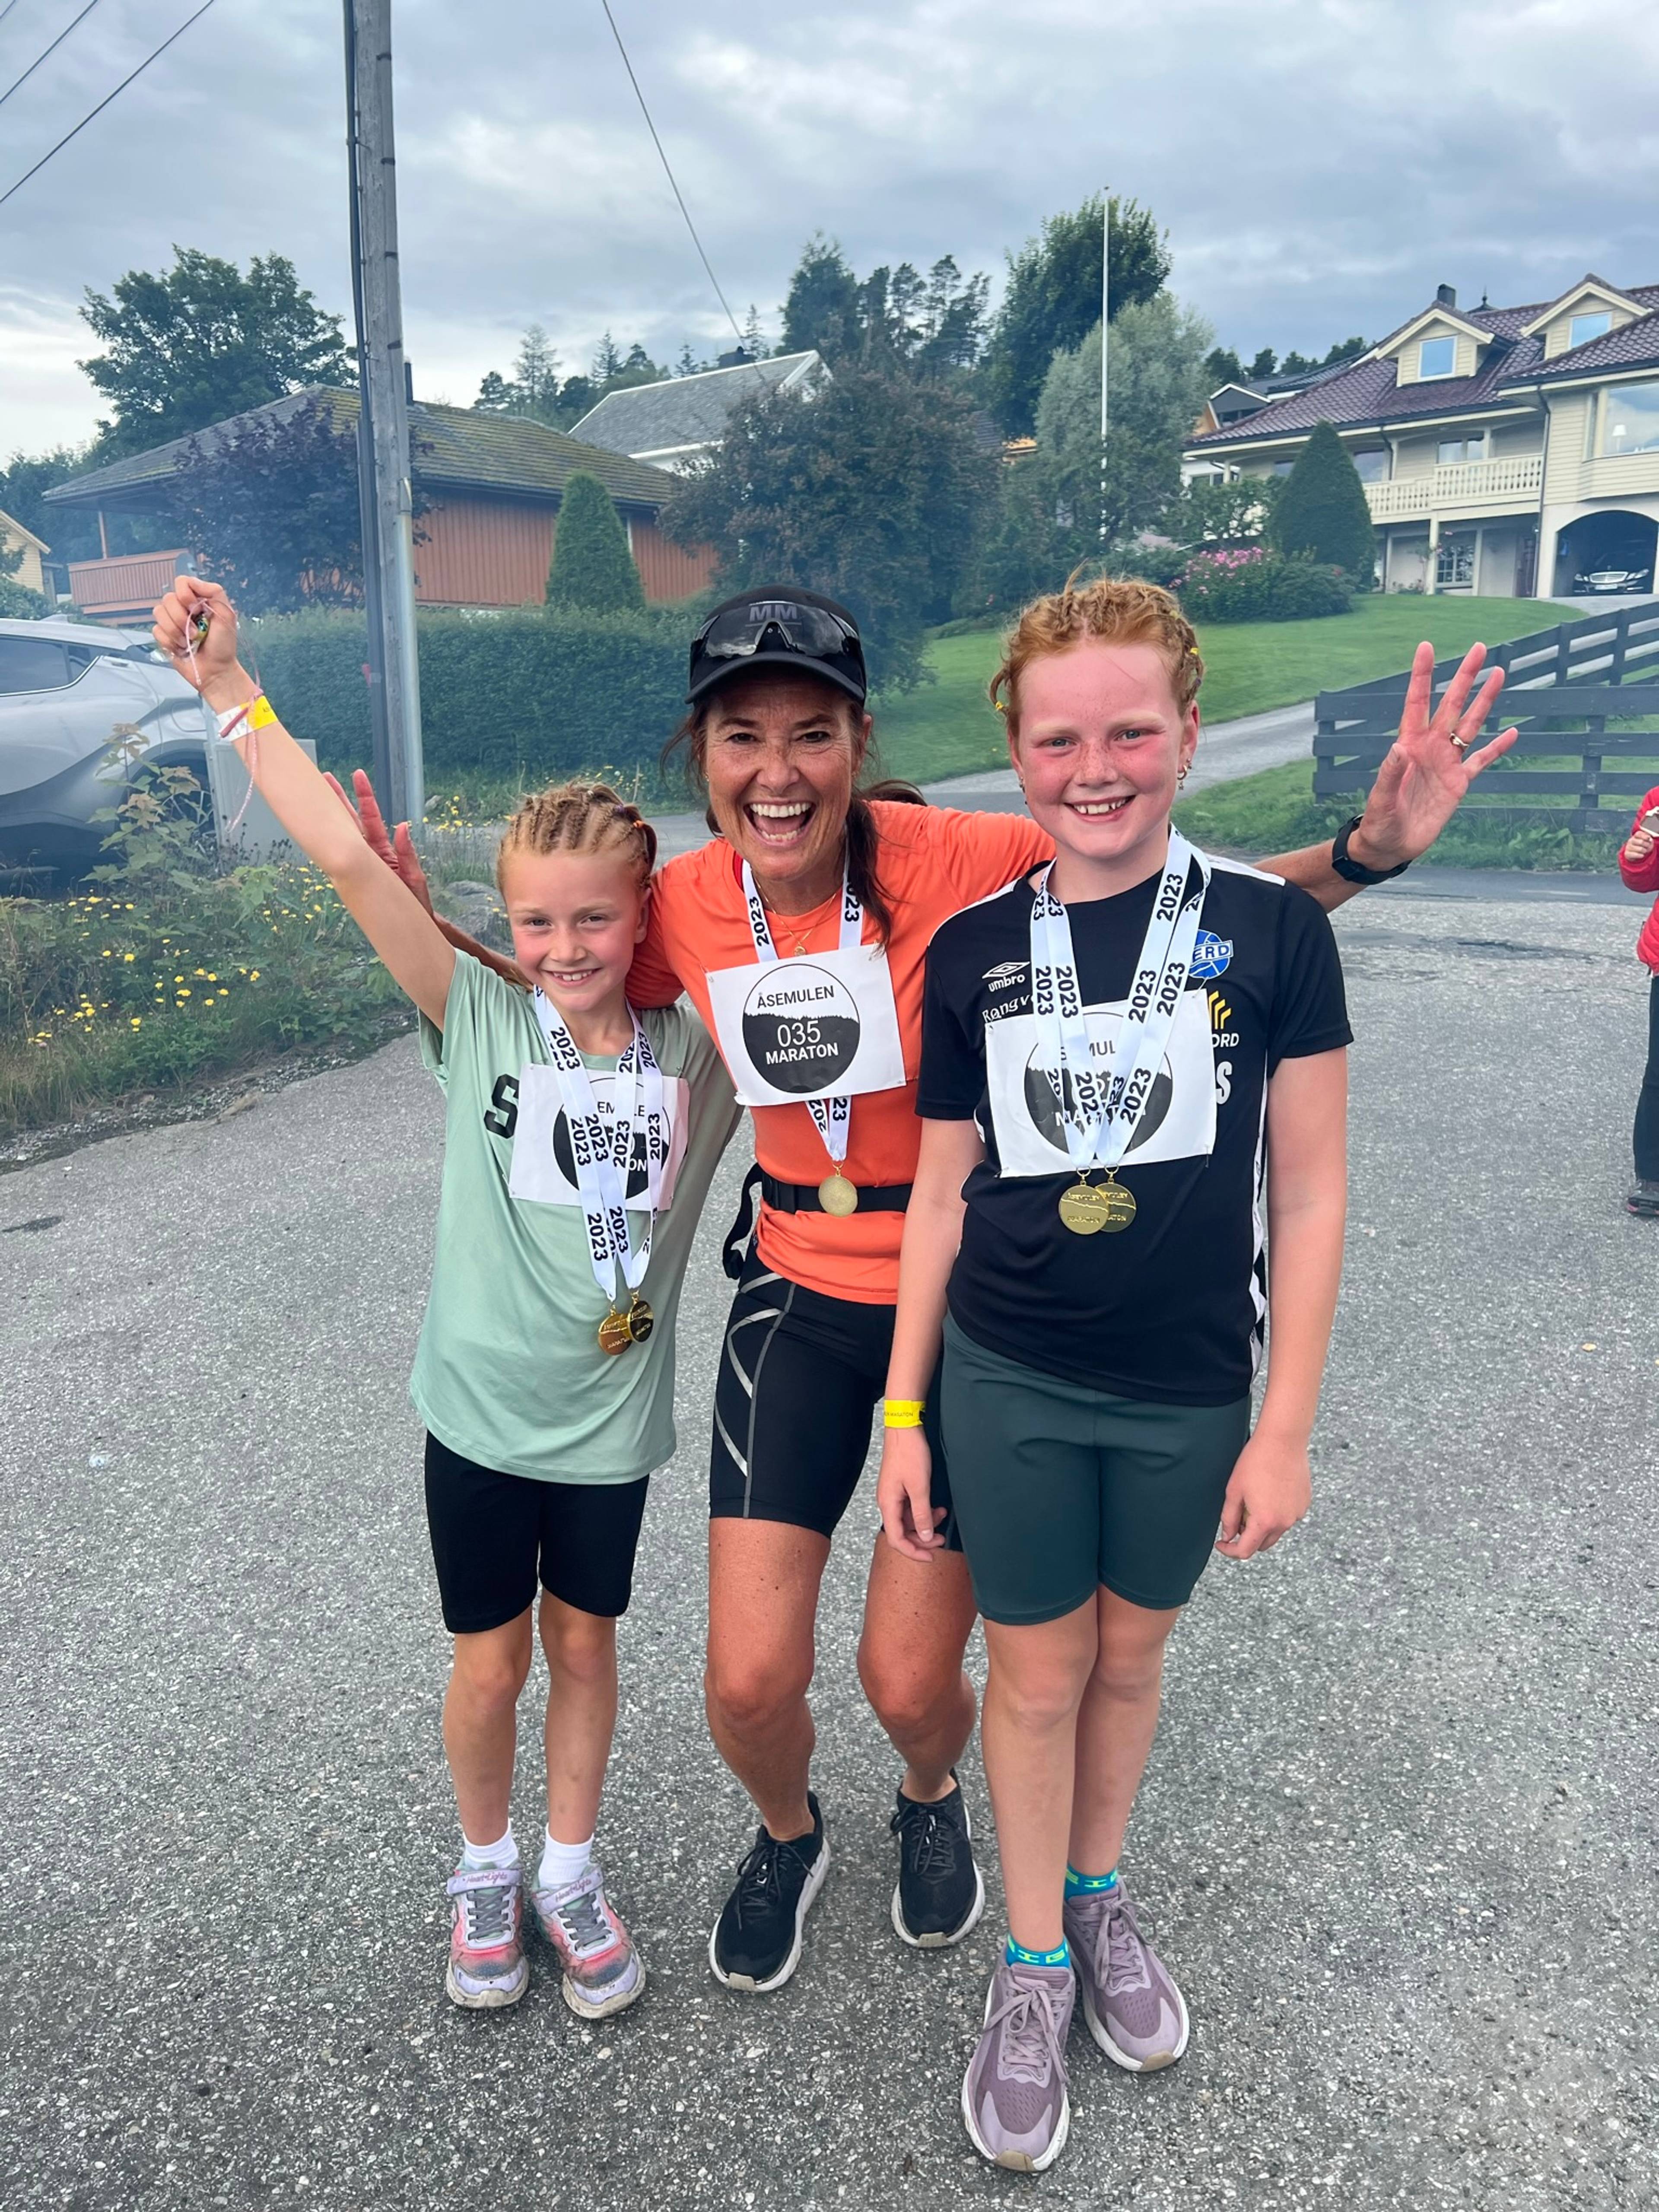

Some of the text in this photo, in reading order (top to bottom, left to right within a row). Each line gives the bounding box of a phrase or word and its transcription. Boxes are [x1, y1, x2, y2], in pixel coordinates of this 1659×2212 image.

[749, 604, 798, 622] MM
[1047, 893, 1064, 916] 23
[1156, 873, 1183, 922] 2023
[749, 896, 770, 947] 2023
[1193, 945, 1230, 963] ERD
[756, 985, 835, 1009] ÅSEMULEN
[988, 974, 1026, 992] umbro
[1035, 965, 1055, 1016] 2023
[1056, 966, 1079, 1019] 2023
[1128, 970, 1157, 1024] 2023
[1156, 962, 1185, 1017] 2023
[550, 1027, 581, 1070] 2023
[638, 1031, 657, 1069] 2023
[765, 1042, 839, 1065] MARATON
[777, 1020, 821, 1048] 035
[1211, 1033, 1239, 1048] ORD
[619, 1042, 635, 1074] 202
[483, 1073, 519, 1139] S
[1120, 1068, 1152, 1125] 2023
[1216, 1061, 1233, 1105] S
[833, 1097, 847, 1122] 23
[571, 1118, 591, 1166] 2023
[585, 1113, 609, 1162] 2023
[613, 1120, 630, 1168] 2023
[648, 1113, 660, 1160] 2023
[587, 1212, 609, 1261] 2023
[609, 1206, 628, 1253] 2023
